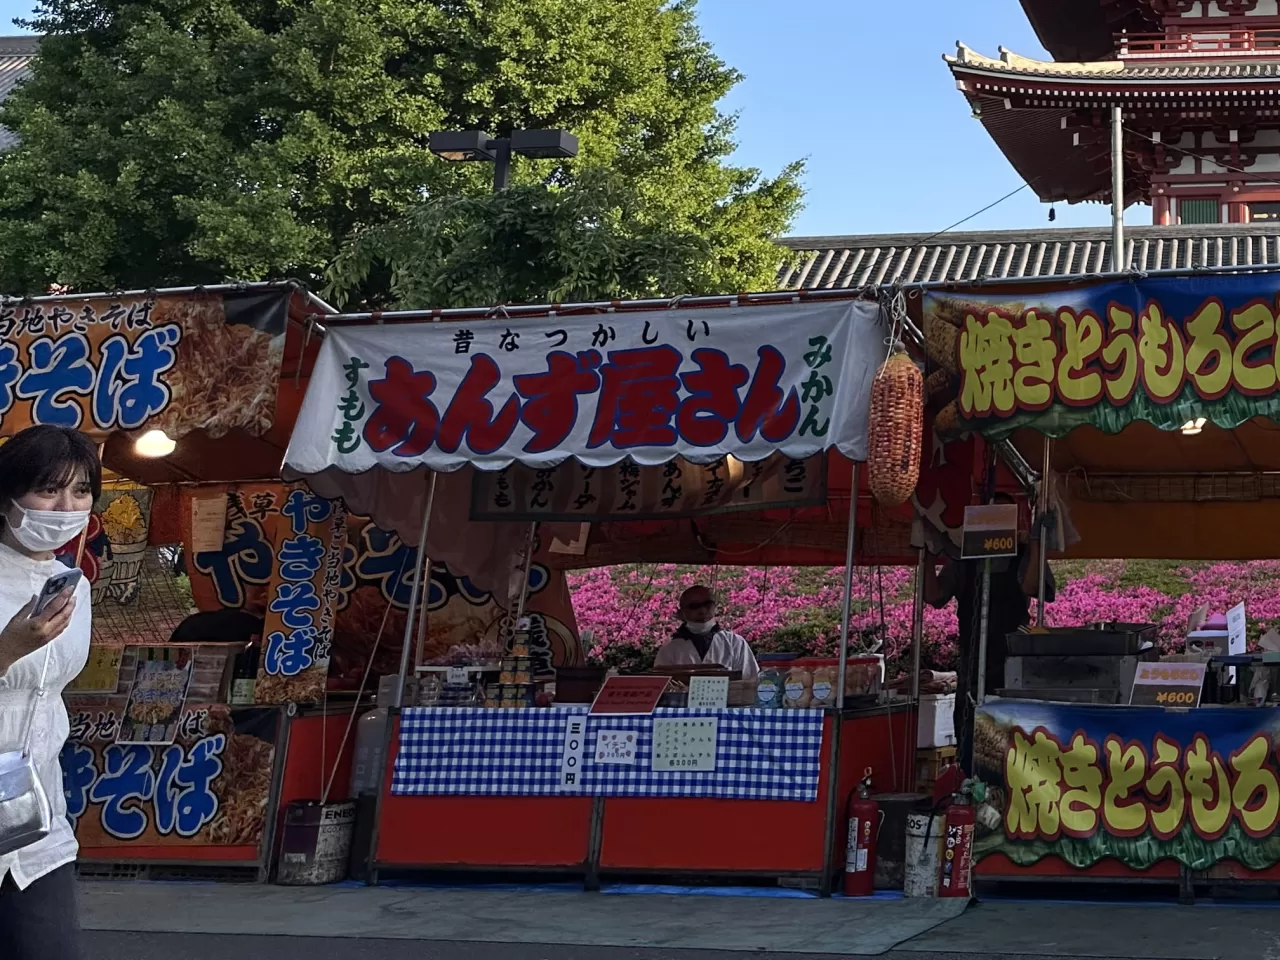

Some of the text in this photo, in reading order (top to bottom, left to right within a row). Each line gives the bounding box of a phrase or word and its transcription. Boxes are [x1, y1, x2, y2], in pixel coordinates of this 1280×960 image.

[452, 319, 711, 355] 昔なつかしい
[798, 334, 834, 438] みかん
[330, 356, 371, 455] すもも
[361, 344, 801, 458] あんず屋さん
[264, 489, 333, 677] やきそば
[1156, 691, 1195, 705] ¥600
